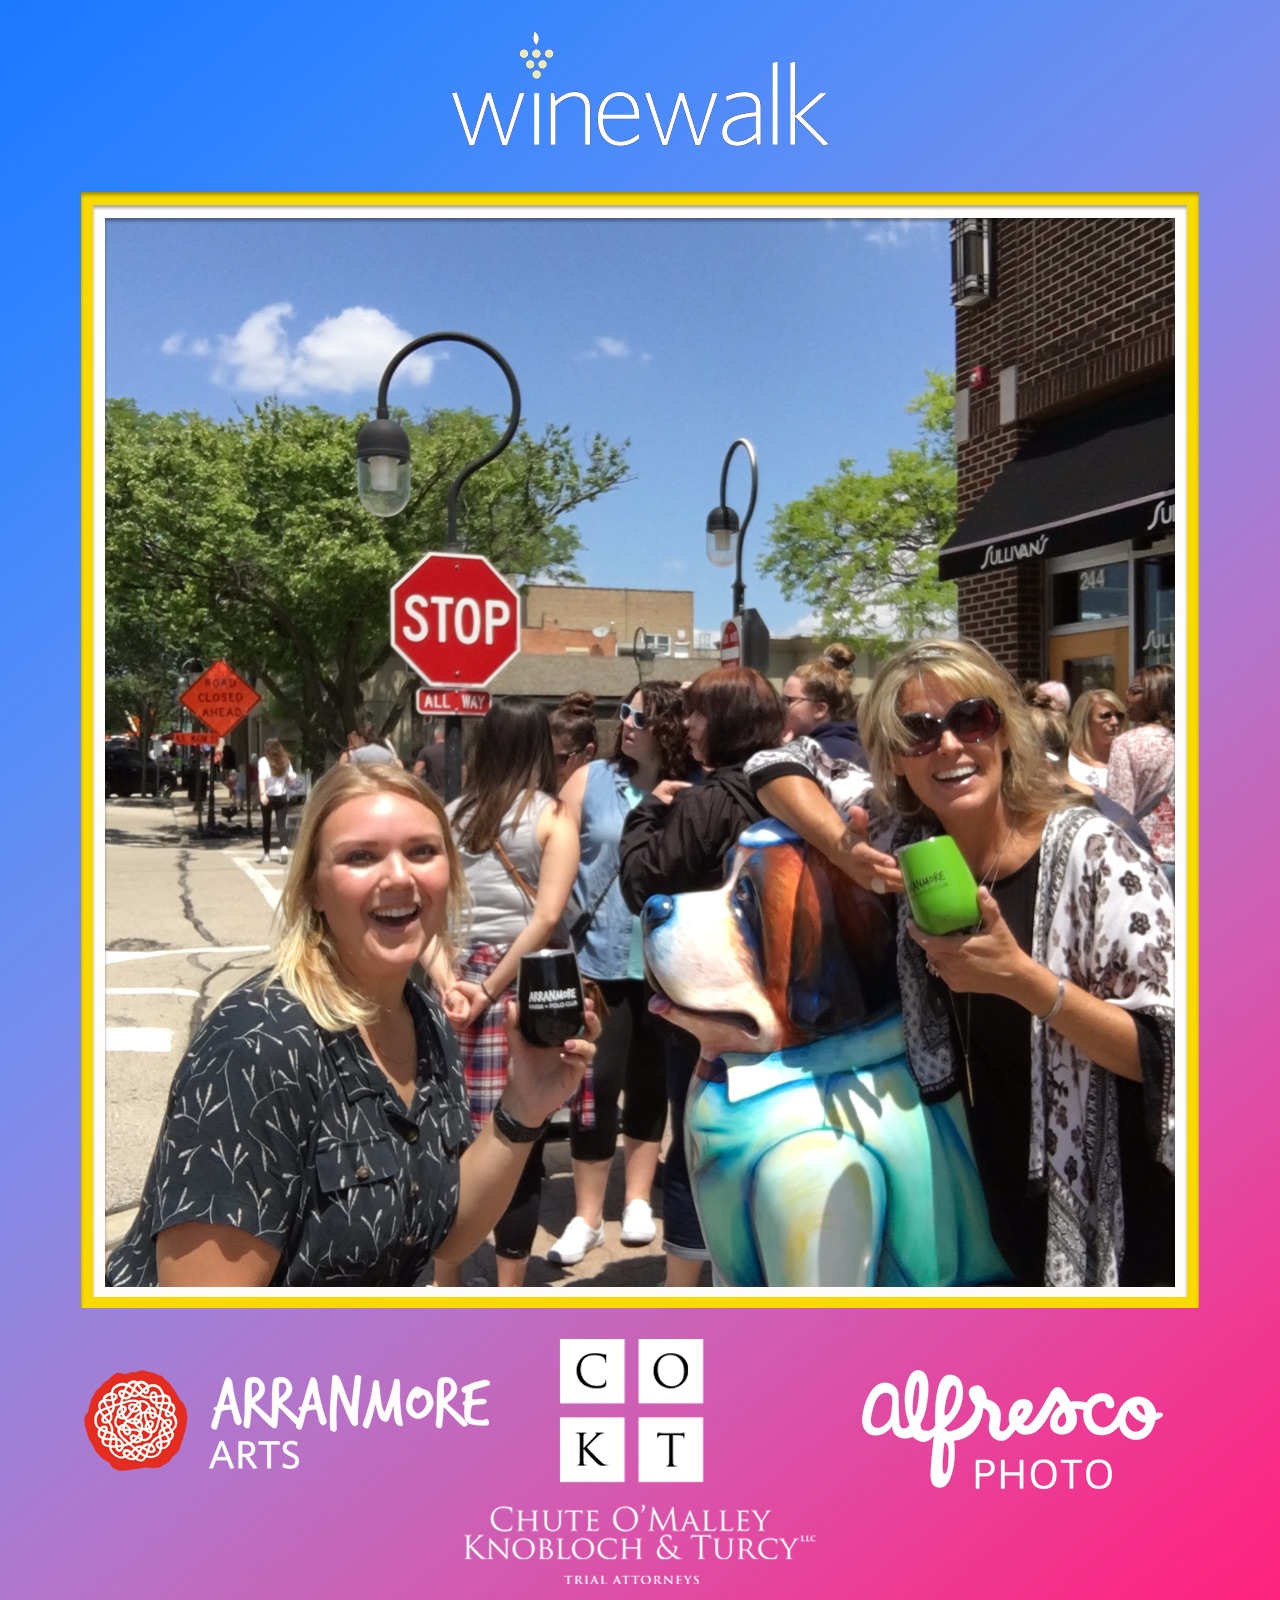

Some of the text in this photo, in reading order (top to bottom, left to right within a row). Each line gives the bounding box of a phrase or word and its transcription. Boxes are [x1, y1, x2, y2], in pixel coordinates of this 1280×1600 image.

[980, 534, 1049, 570] SULLIVAN'S
[1080, 569, 1105, 590] 244
[402, 594, 510, 645] STOP
[205, 679, 236, 688] ROAD
[198, 693, 243, 702] CLOSED
[424, 694, 486, 710] ALL WAY
[202, 708, 242, 717] AHEAD
[528, 988, 576, 1002] ARRANMORE
[549, 1001, 565, 1009] POLO
